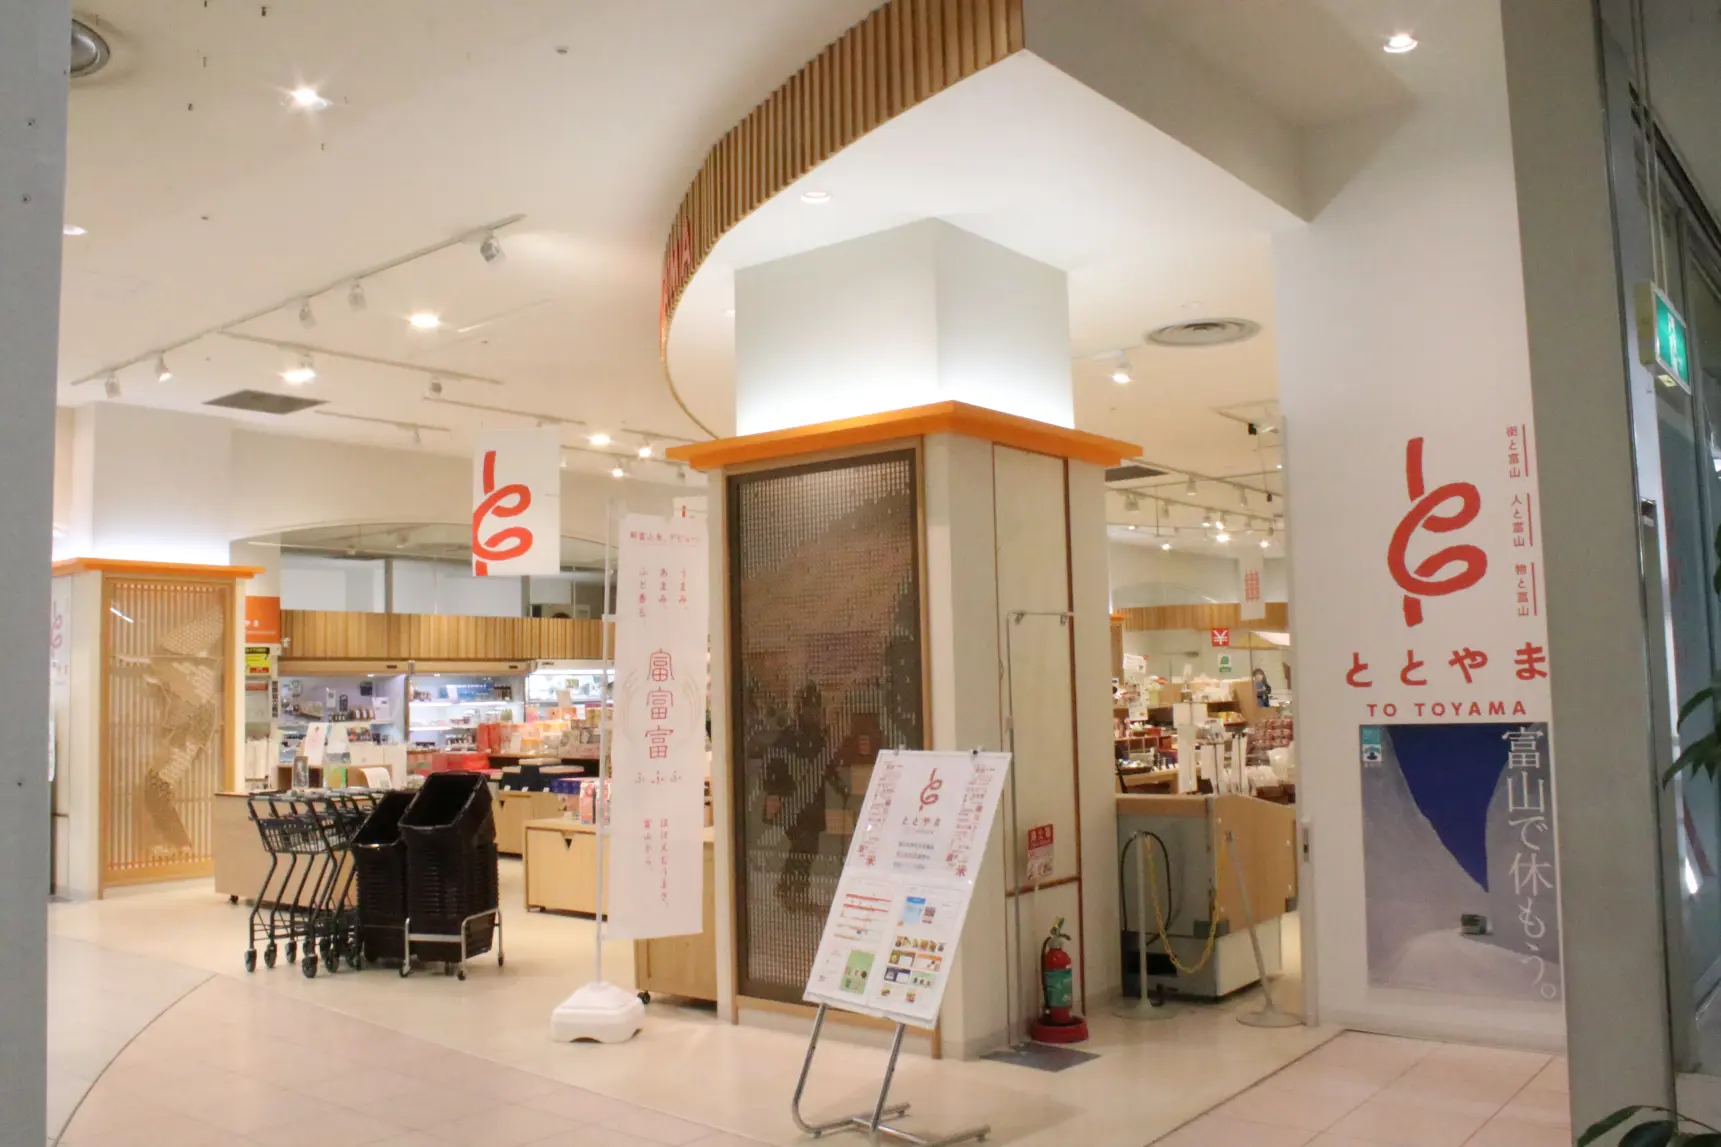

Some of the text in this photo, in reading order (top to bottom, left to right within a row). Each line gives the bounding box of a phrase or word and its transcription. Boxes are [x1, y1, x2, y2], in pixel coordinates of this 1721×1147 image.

[1511, 494, 1526, 548] 人と富山
[1346, 642, 1548, 687] ととやま
[1367, 700, 1527, 717] TO TOYAMA
[1502, 726, 1557, 999] 富山で休もう。
